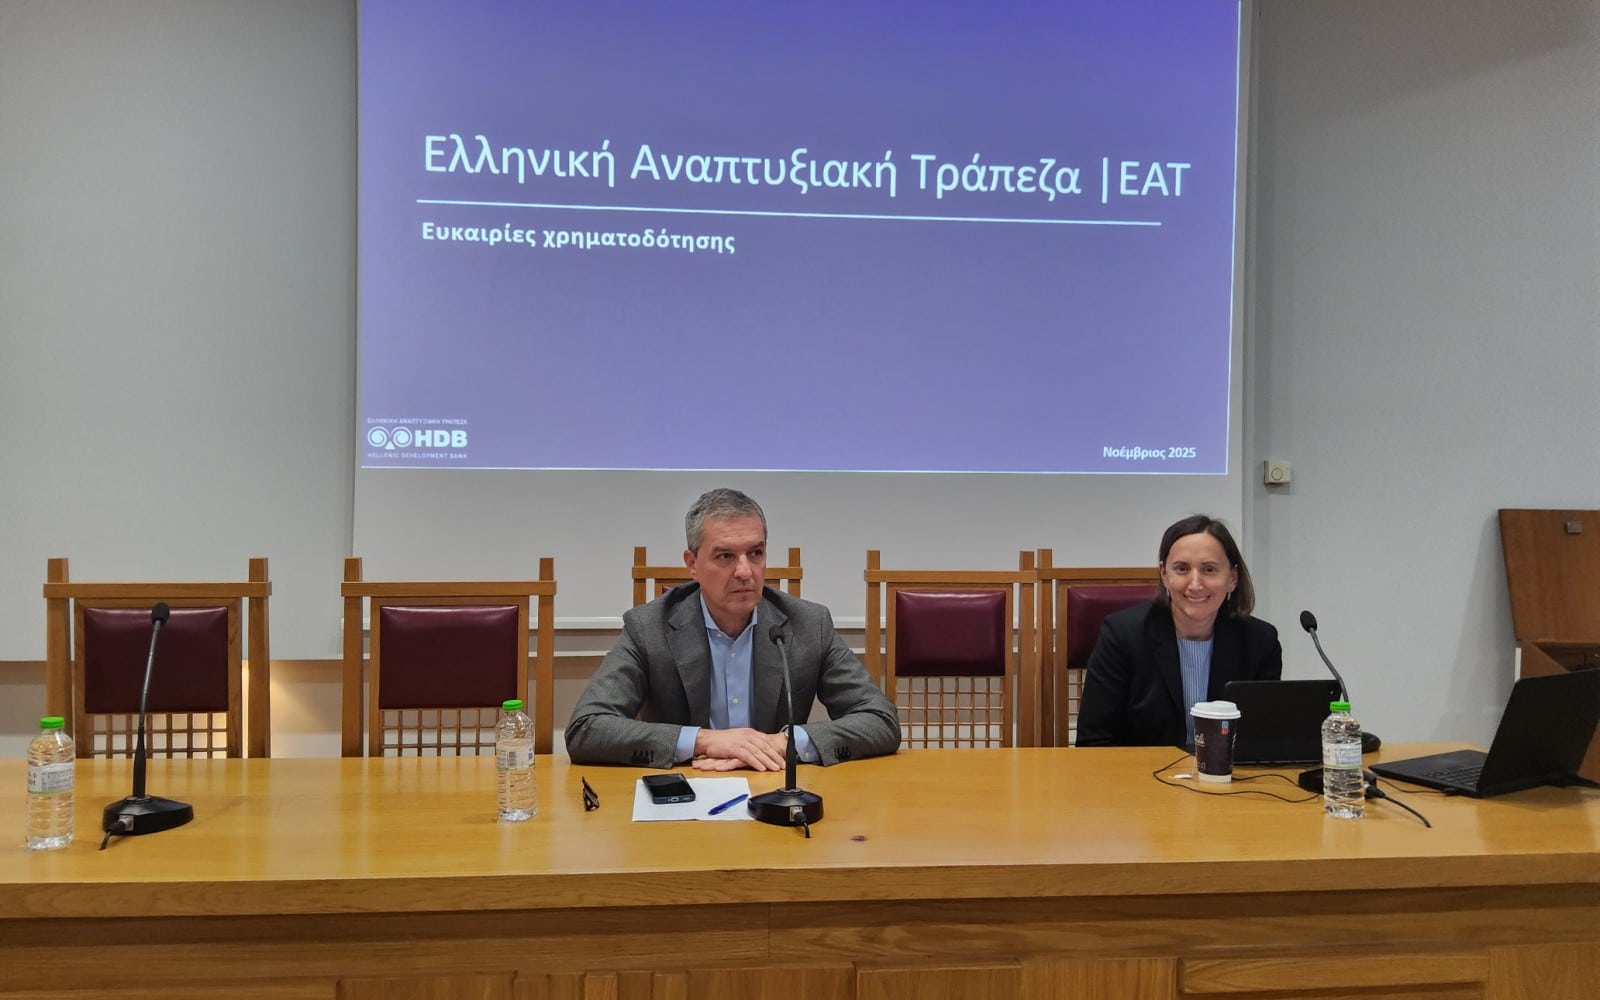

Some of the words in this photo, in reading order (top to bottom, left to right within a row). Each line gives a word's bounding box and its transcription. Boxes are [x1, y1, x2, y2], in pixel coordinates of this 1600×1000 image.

[425, 133, 615, 188] Ελληνική
[630, 144, 897, 198] Αναπτυξιακή
[911, 153, 1082, 201] Τράπεζα
[422, 221, 536, 247] Ευκαιρίες
[543, 227, 736, 254] χρηματοδότησης
[414, 429, 468, 448] HDB
[401, 452, 448, 460] DEVELOPMENT
[1103, 446, 1166, 461] Νοέμβριος
[1168, 447, 1197, 458] 2025
